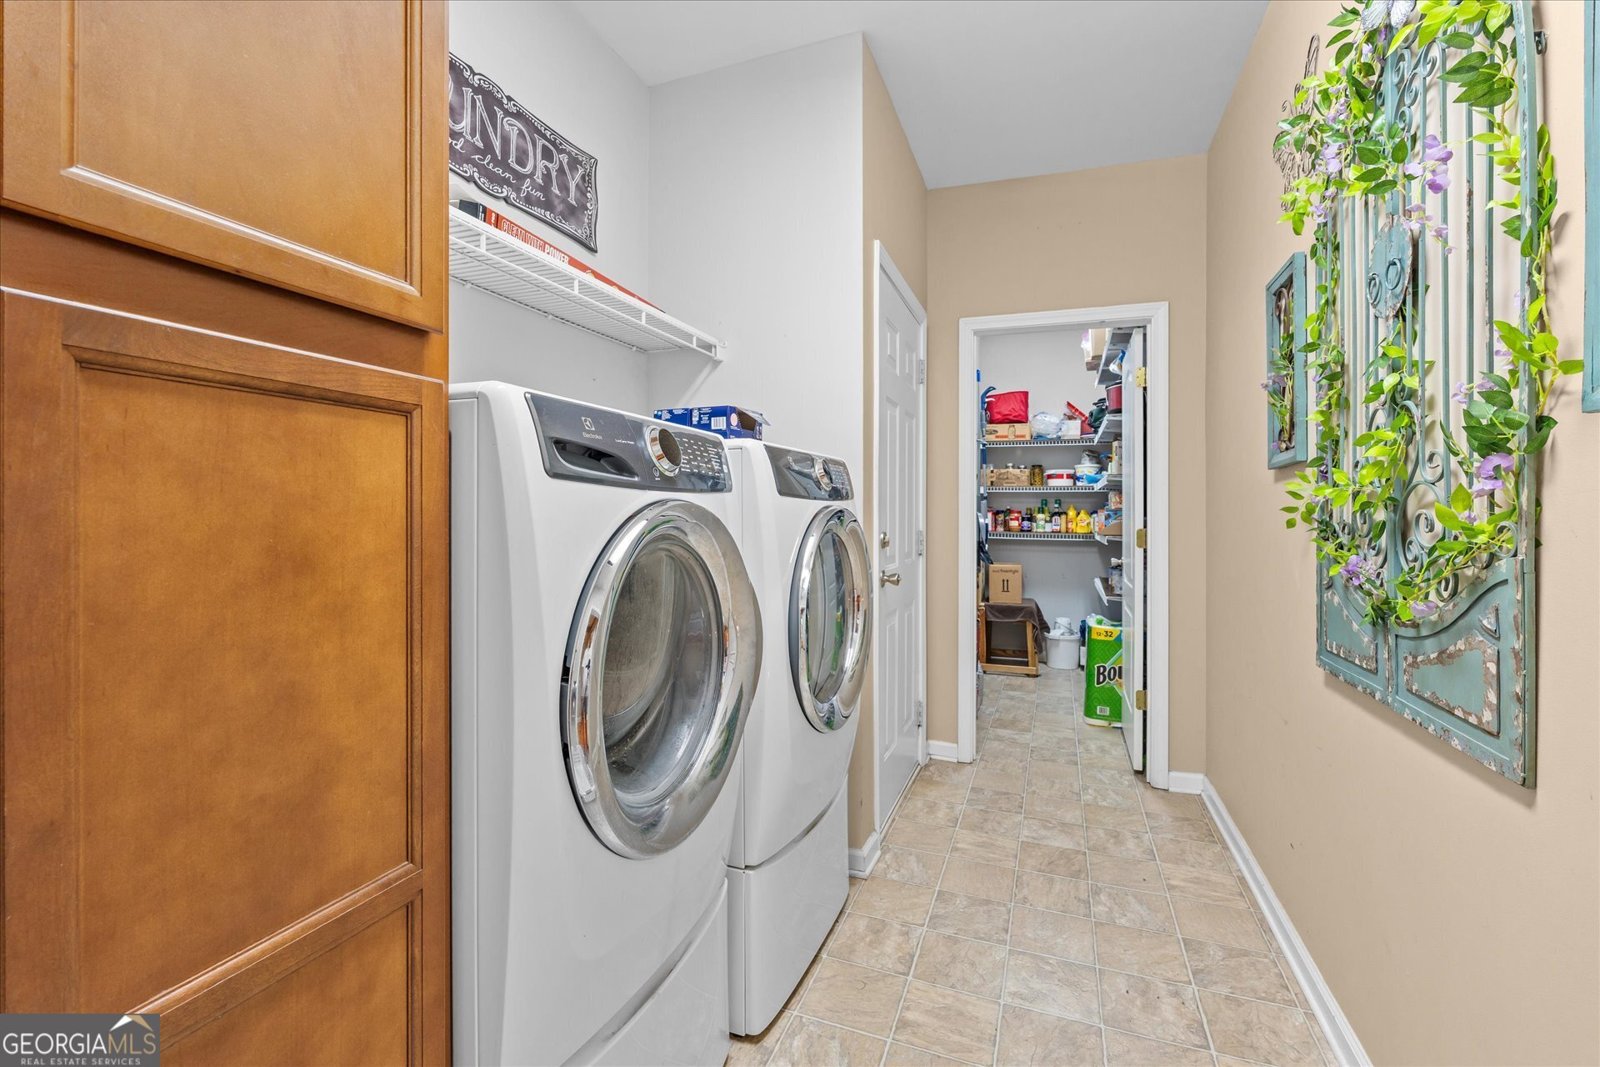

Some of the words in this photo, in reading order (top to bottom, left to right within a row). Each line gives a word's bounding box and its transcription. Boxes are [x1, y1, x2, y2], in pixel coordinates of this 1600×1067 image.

[471, 155, 516, 183] clean
[521, 179, 545, 200] fun
[502, 219, 526, 244] CLEAN
